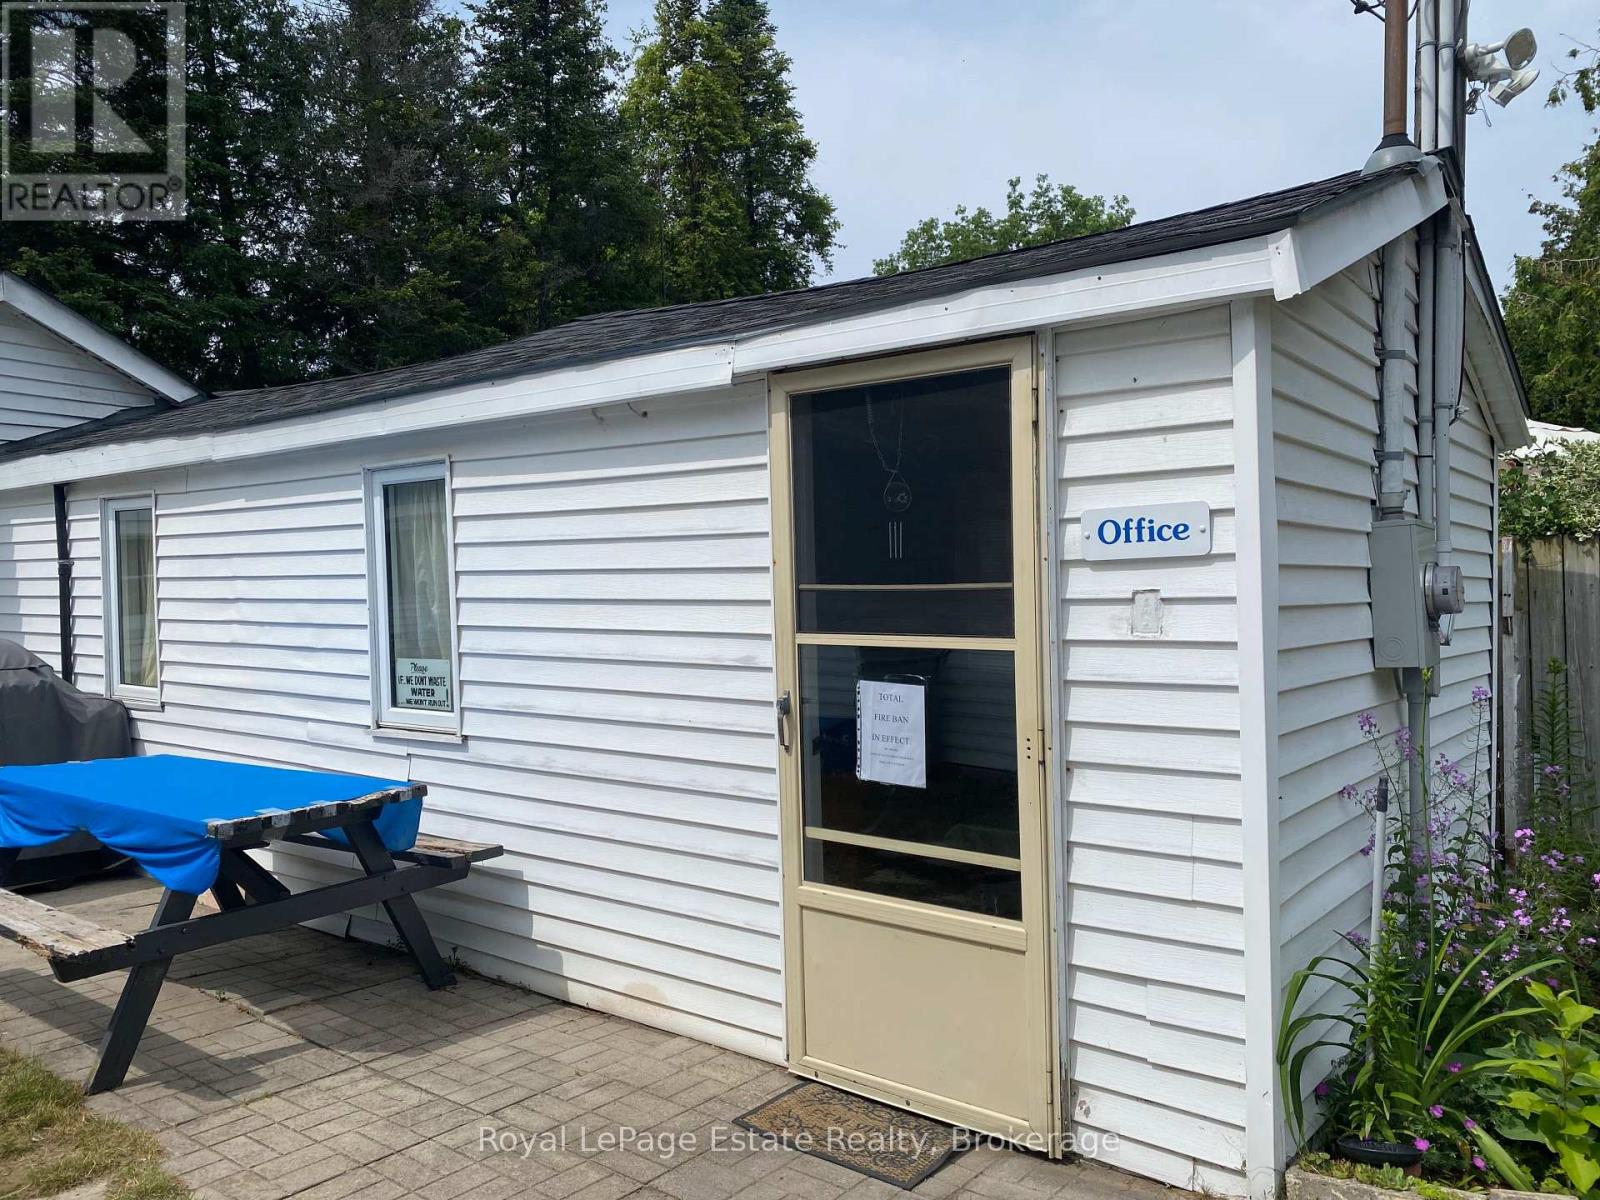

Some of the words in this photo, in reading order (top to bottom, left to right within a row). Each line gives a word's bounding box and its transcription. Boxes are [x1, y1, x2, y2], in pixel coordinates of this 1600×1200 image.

[1097, 517, 1190, 545] Office
[406, 675, 414, 686] WE
[428, 676, 447, 687] WASTE
[411, 687, 435, 697] WATER
[874, 713, 891, 722] FIRE
[892, 715, 909, 724] BAN
[871, 733, 880, 742] IN
[881, 734, 911, 746] EFFECT
